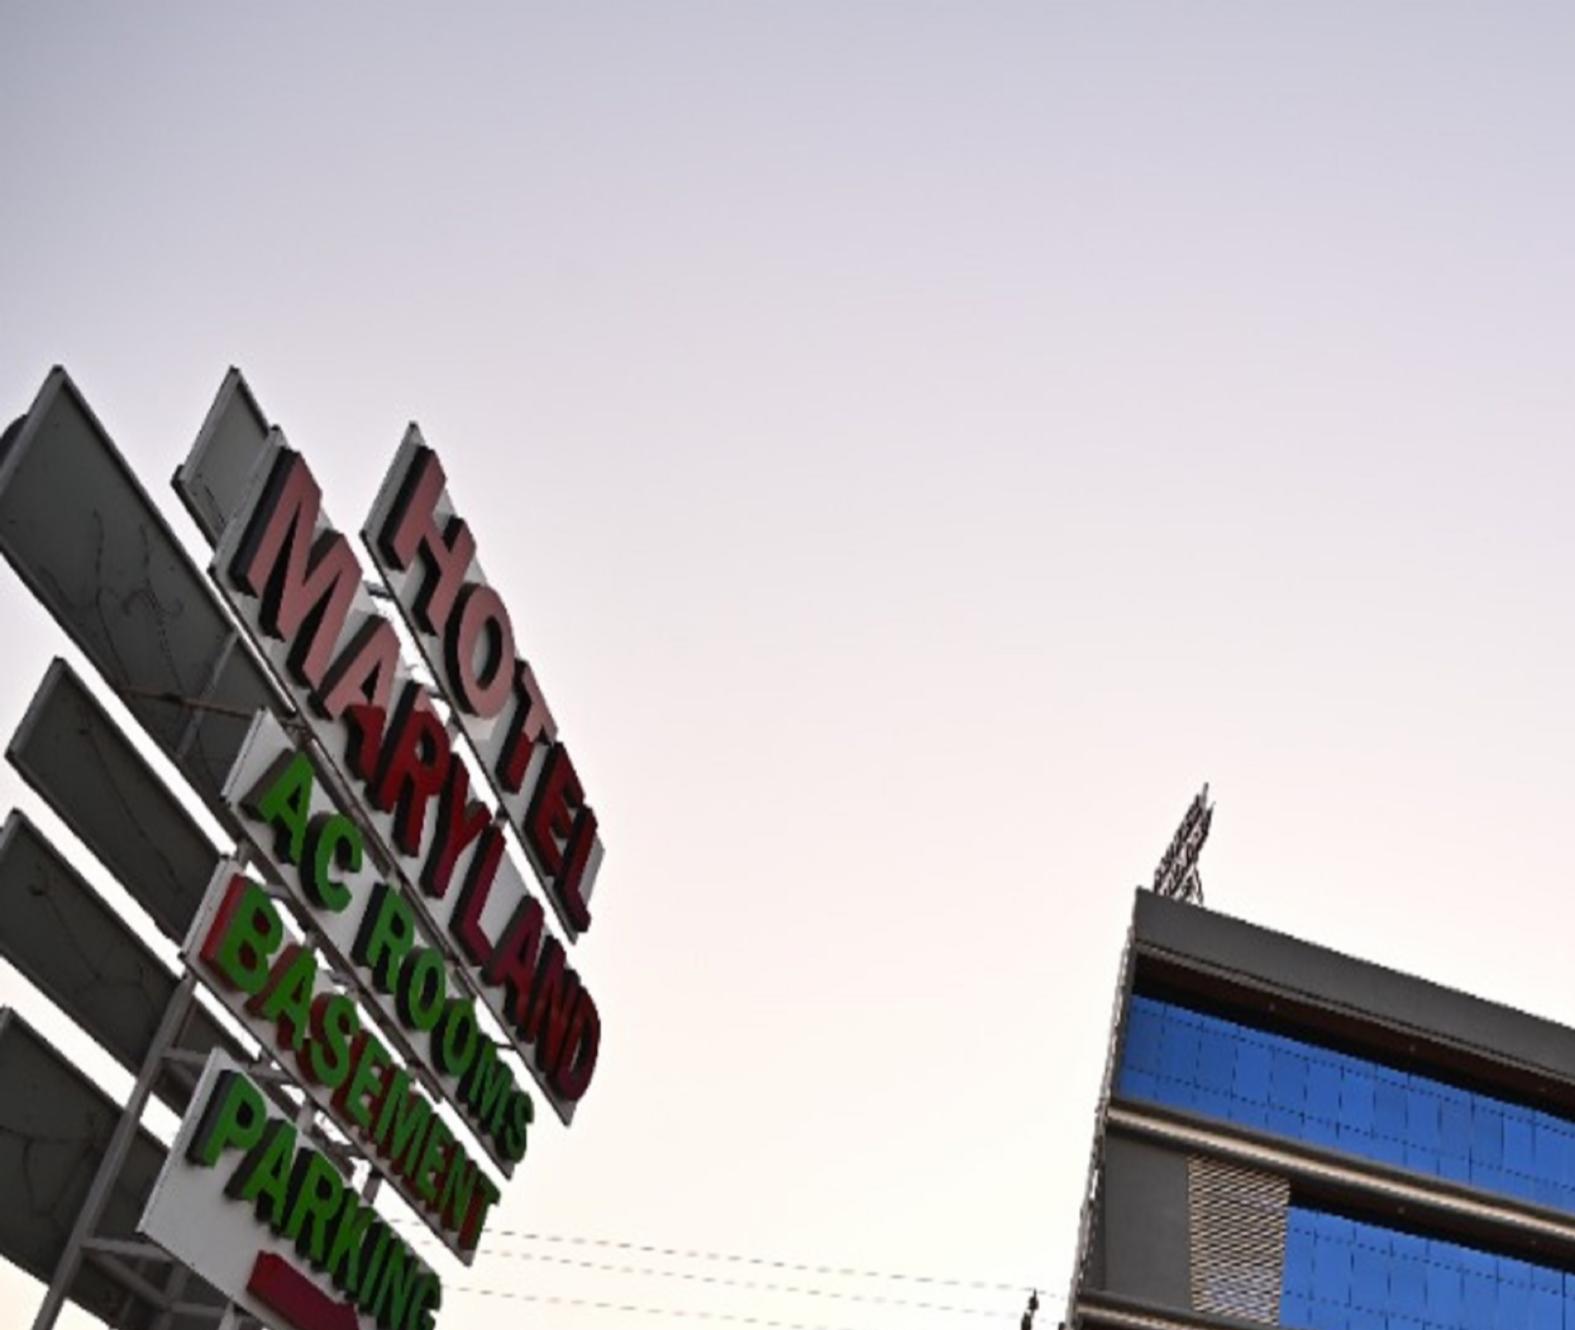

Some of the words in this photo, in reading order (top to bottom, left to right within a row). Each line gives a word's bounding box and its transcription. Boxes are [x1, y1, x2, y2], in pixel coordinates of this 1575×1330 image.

[230, 448, 602, 1101] MARYLAND
[377, 446, 600, 932] HOTEL
[199, 873, 501, 1254] BASEMENT
[249, 748, 365, 912] AC
[352, 884, 535, 1165] ROOMS
